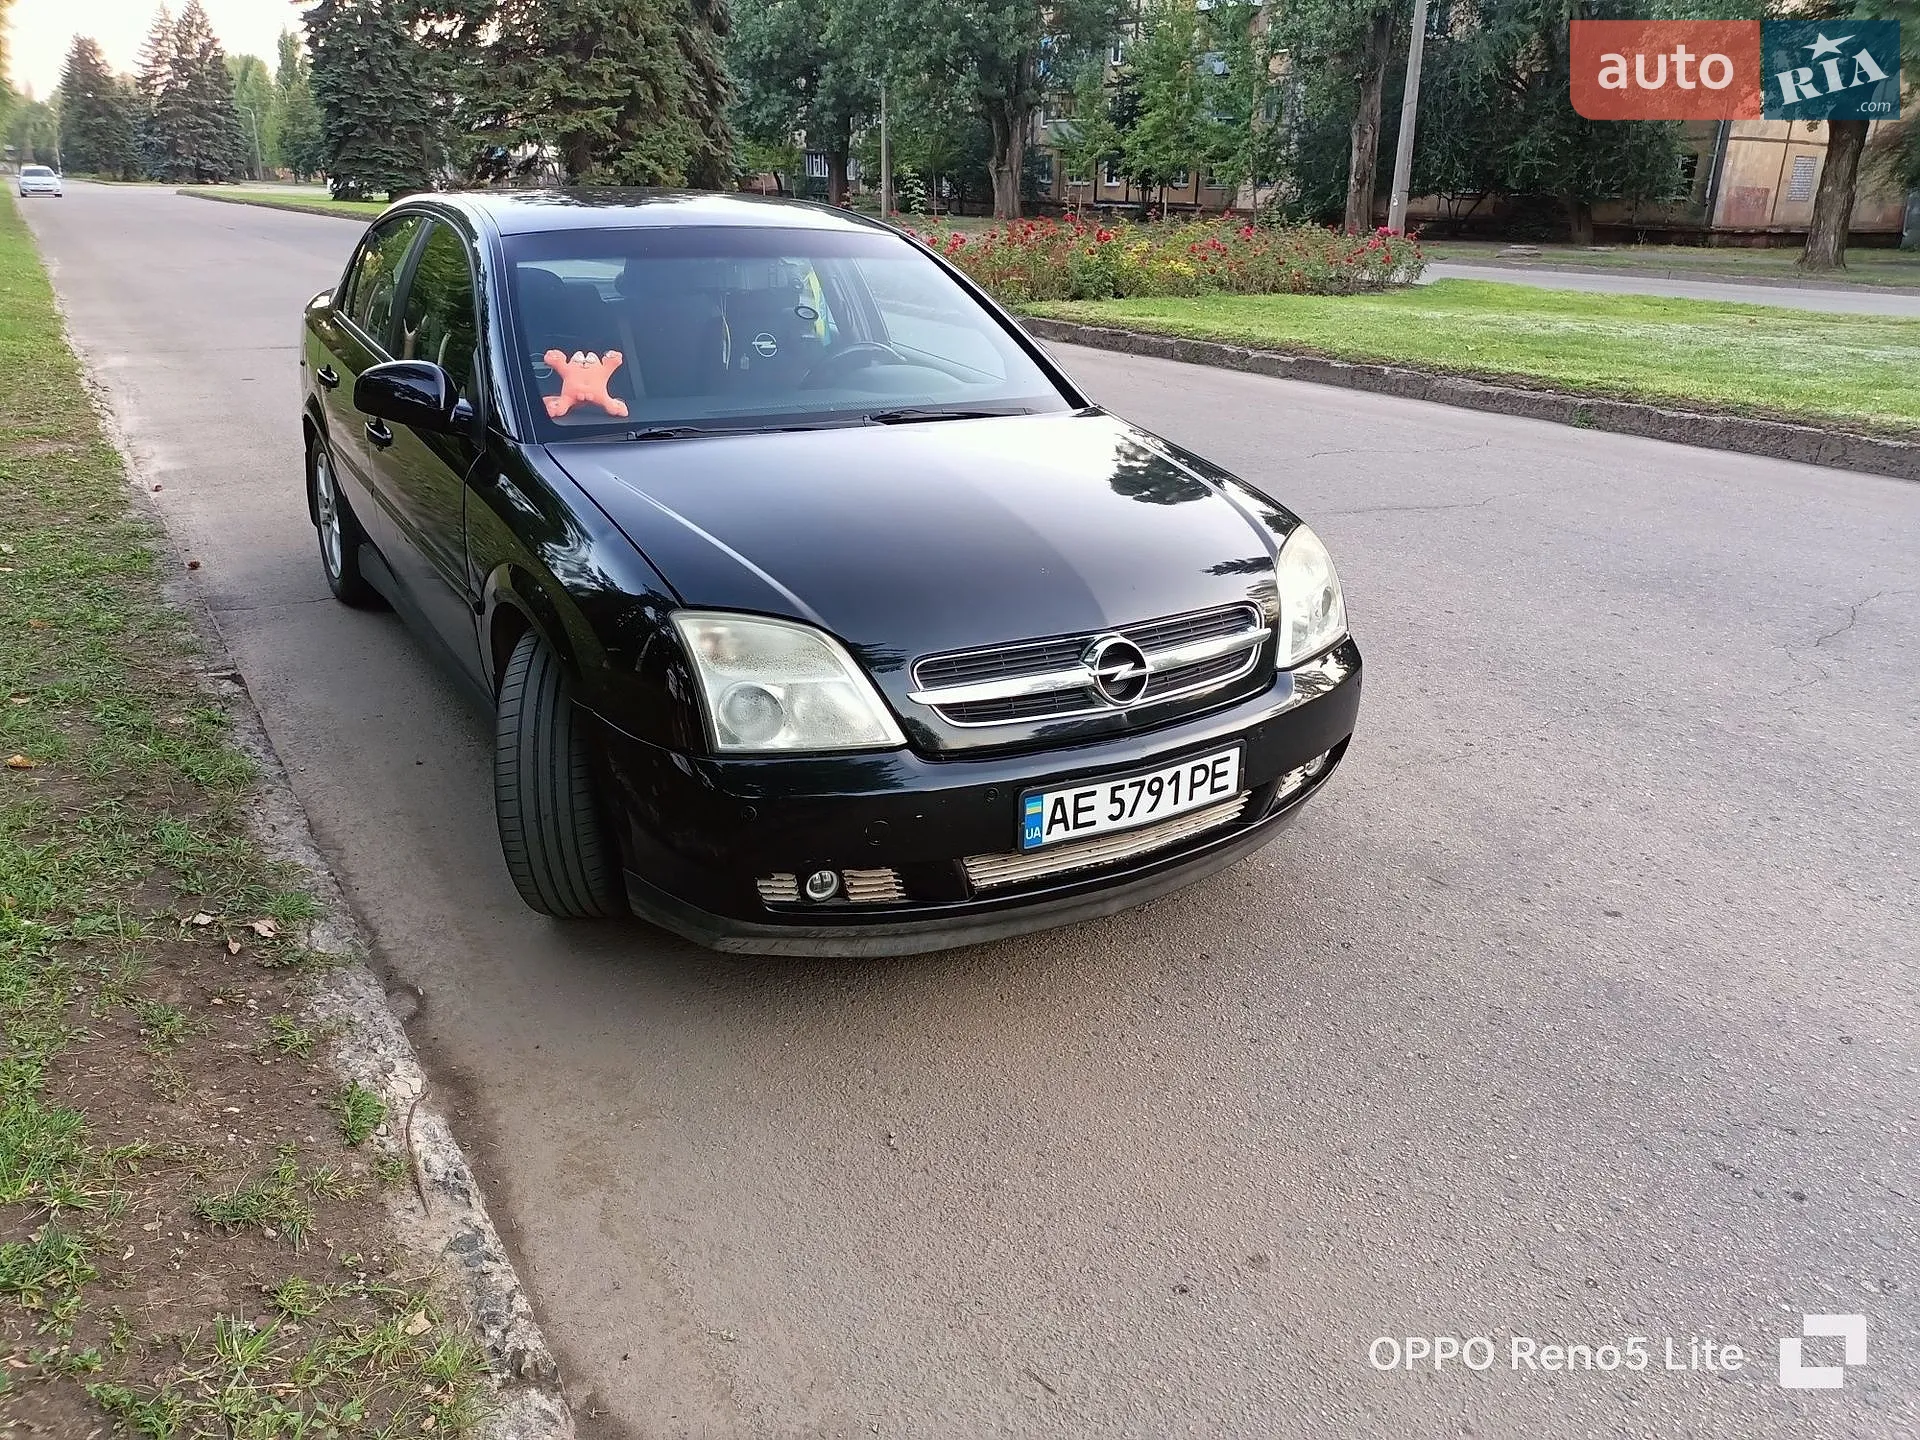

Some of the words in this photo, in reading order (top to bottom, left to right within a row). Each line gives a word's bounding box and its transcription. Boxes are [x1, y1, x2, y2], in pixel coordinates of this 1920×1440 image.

[1046, 790, 1097, 836] AE
[1107, 770, 1182, 822] 5791
[1025, 829, 1042, 840] UA
